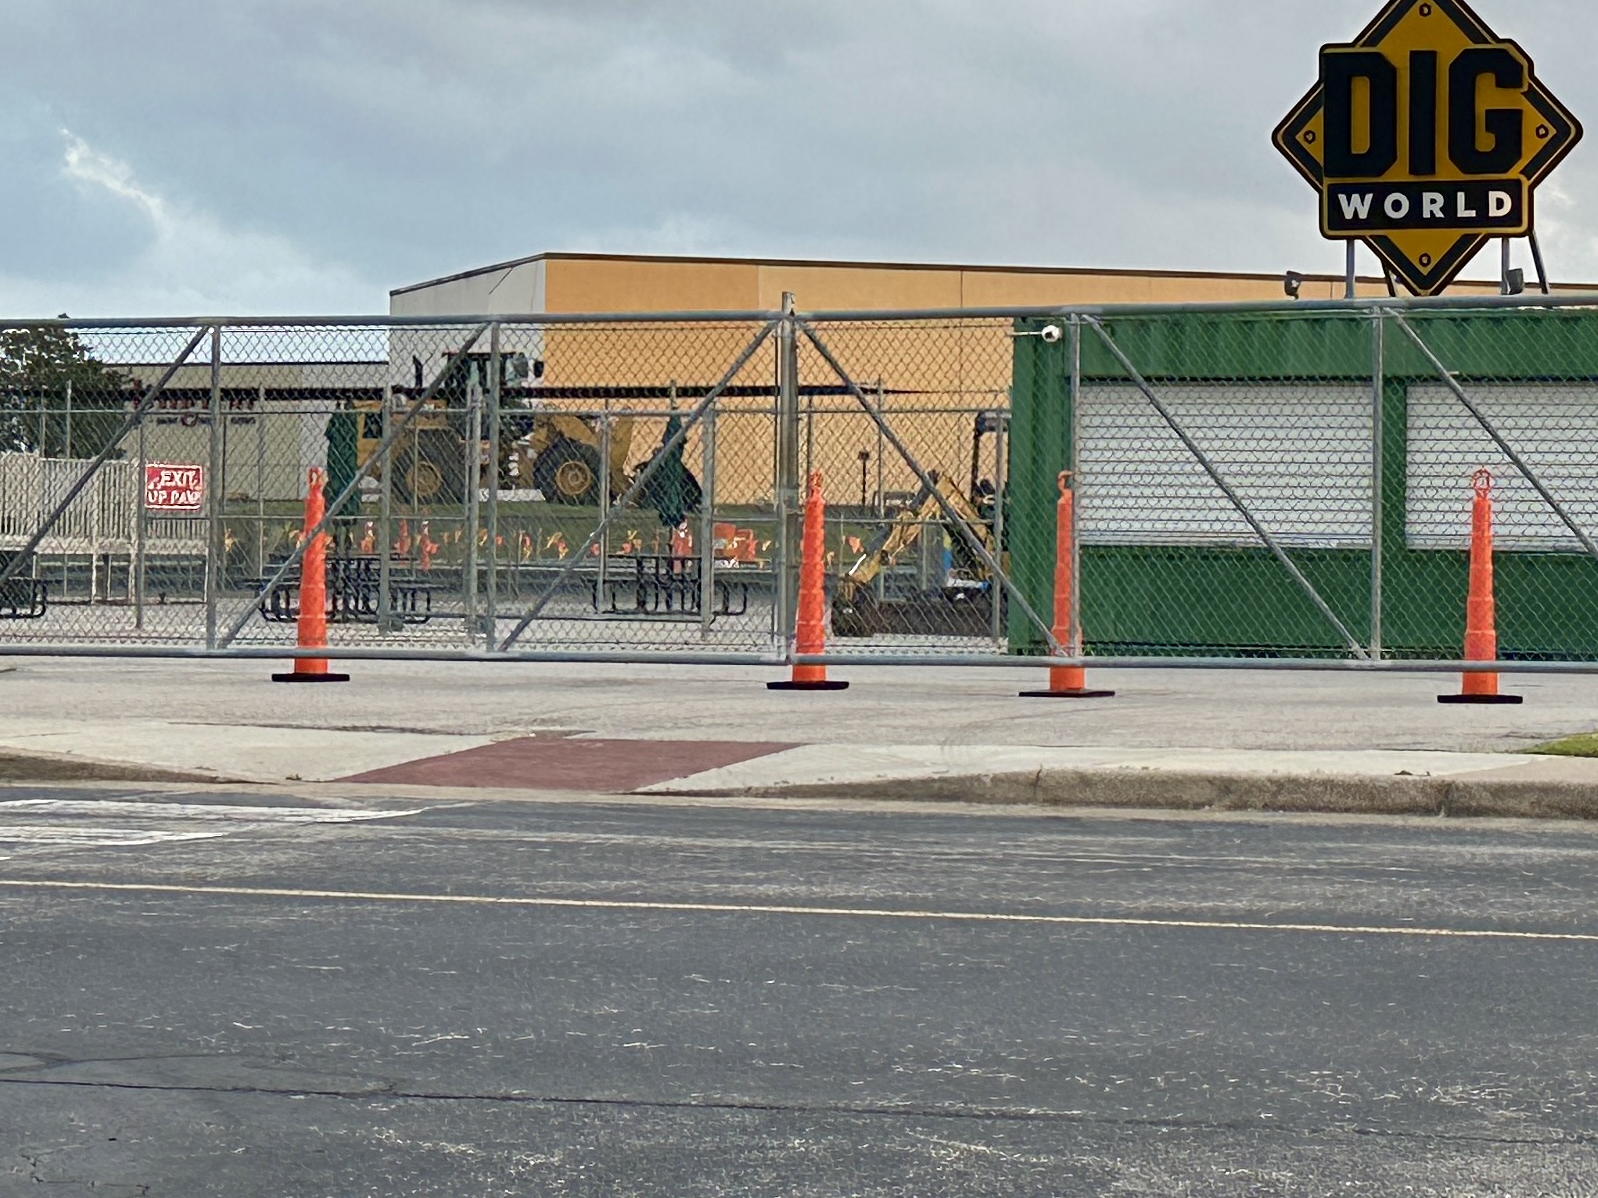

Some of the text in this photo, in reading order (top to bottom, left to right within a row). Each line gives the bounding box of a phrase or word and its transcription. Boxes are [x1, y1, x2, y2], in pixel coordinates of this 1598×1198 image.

[1323, 48, 1524, 177] DIG
[1337, 190, 1513, 220] WORLD
[160, 470, 196, 488] EXIT
